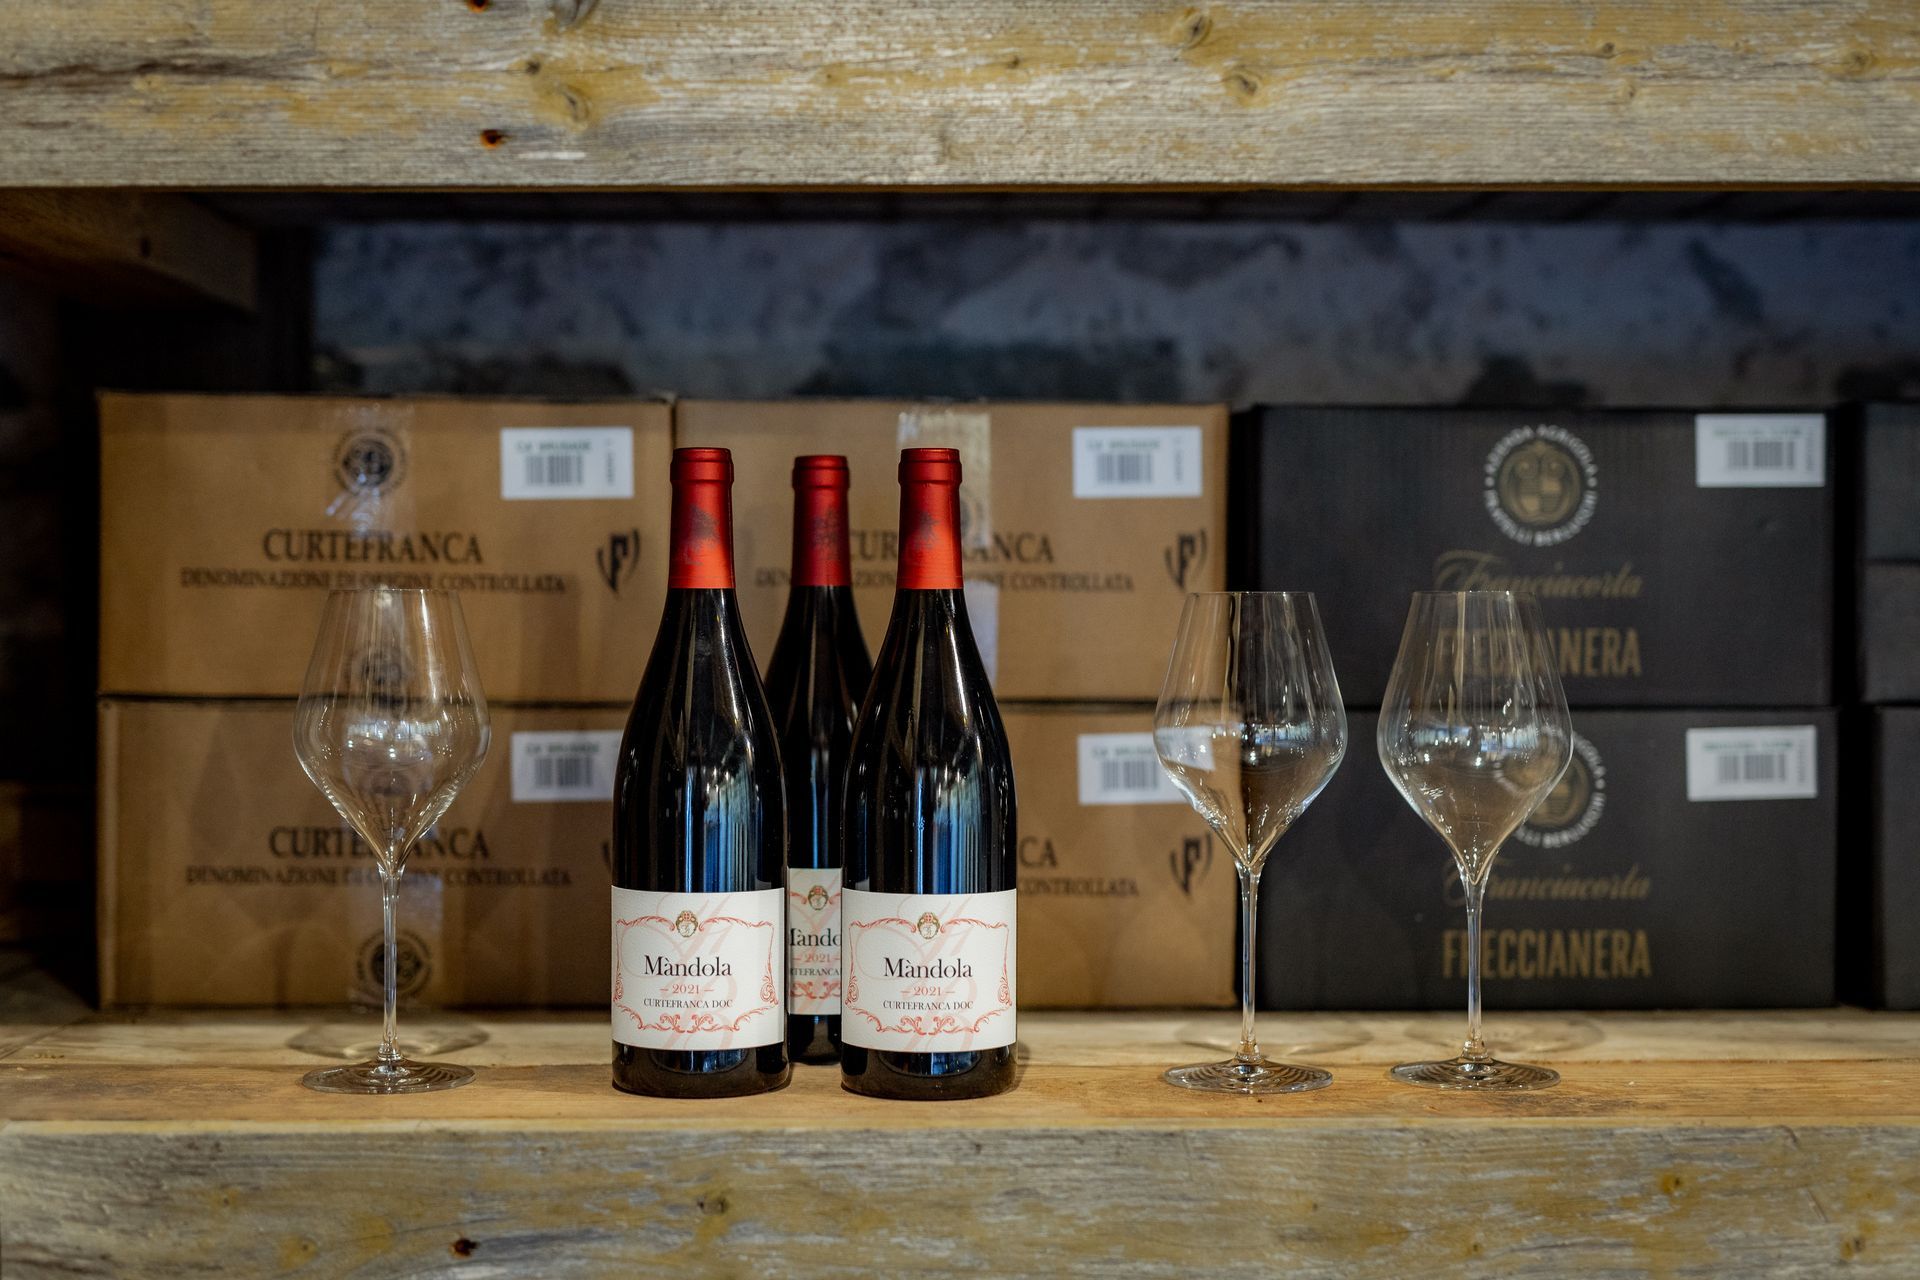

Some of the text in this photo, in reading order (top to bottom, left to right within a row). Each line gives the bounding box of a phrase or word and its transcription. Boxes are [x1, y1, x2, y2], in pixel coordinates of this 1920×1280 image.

[263, 528, 484, 564] CURTEFRANCA
[804, 953, 830, 963] 2021
[644, 955, 732, 977] Màndola
[884, 957, 973, 979] Màndola
[672, 984, 700, 994] 2021
[914, 987, 941, 996] 2021
[643, 998, 733, 1009] CURTEFRANCA DOC
[883, 1000, 974, 1010] CURTEFRANCA DOC
